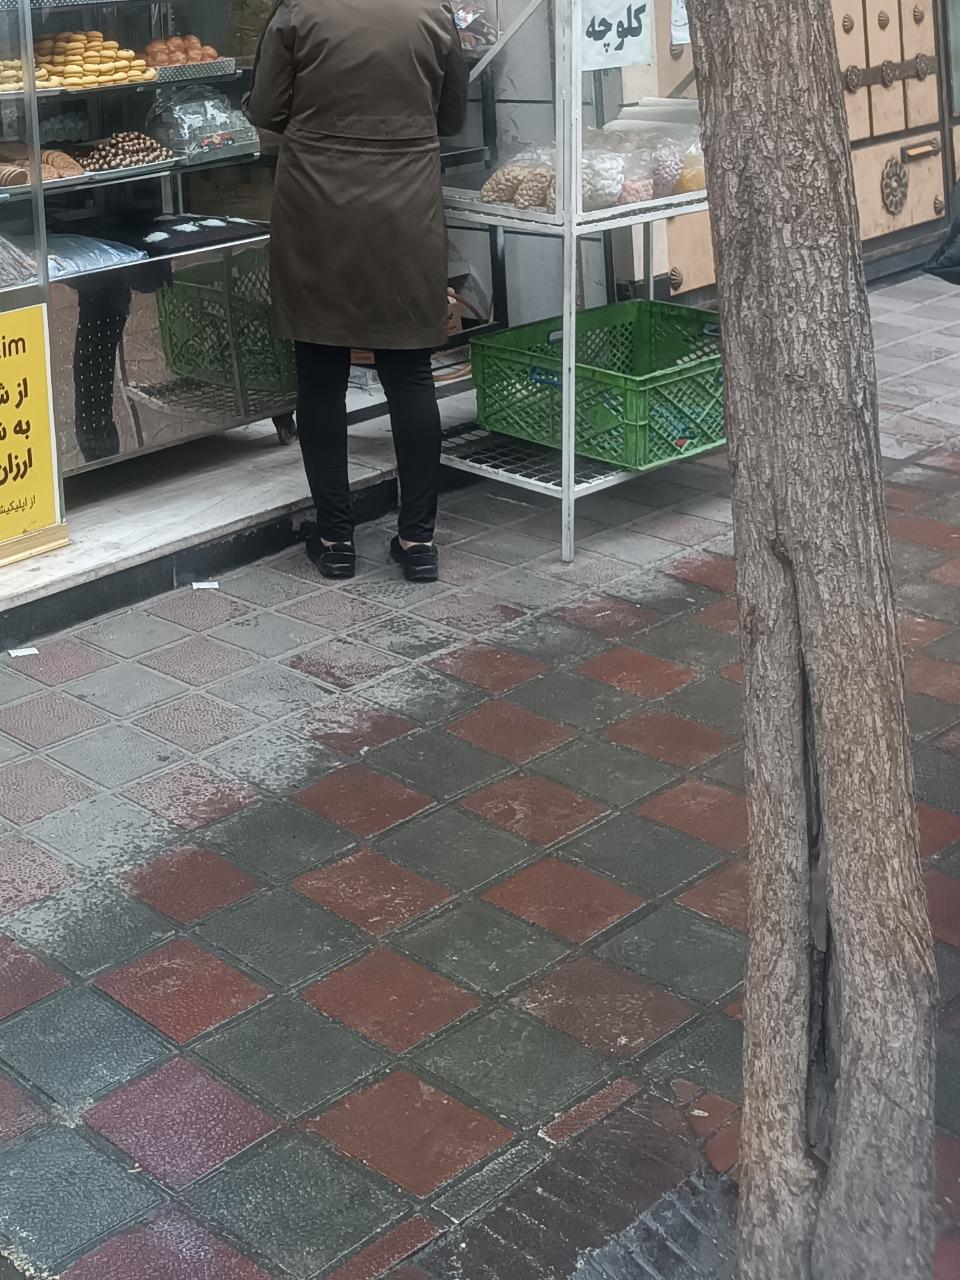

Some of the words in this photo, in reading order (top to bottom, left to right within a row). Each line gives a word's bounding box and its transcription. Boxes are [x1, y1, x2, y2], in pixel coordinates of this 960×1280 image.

[585, 3, 647, 53] کلوچه
[15, 377, 29, 409] از
[13, 419, 31, 440] به
[29, 494, 36, 509] از
